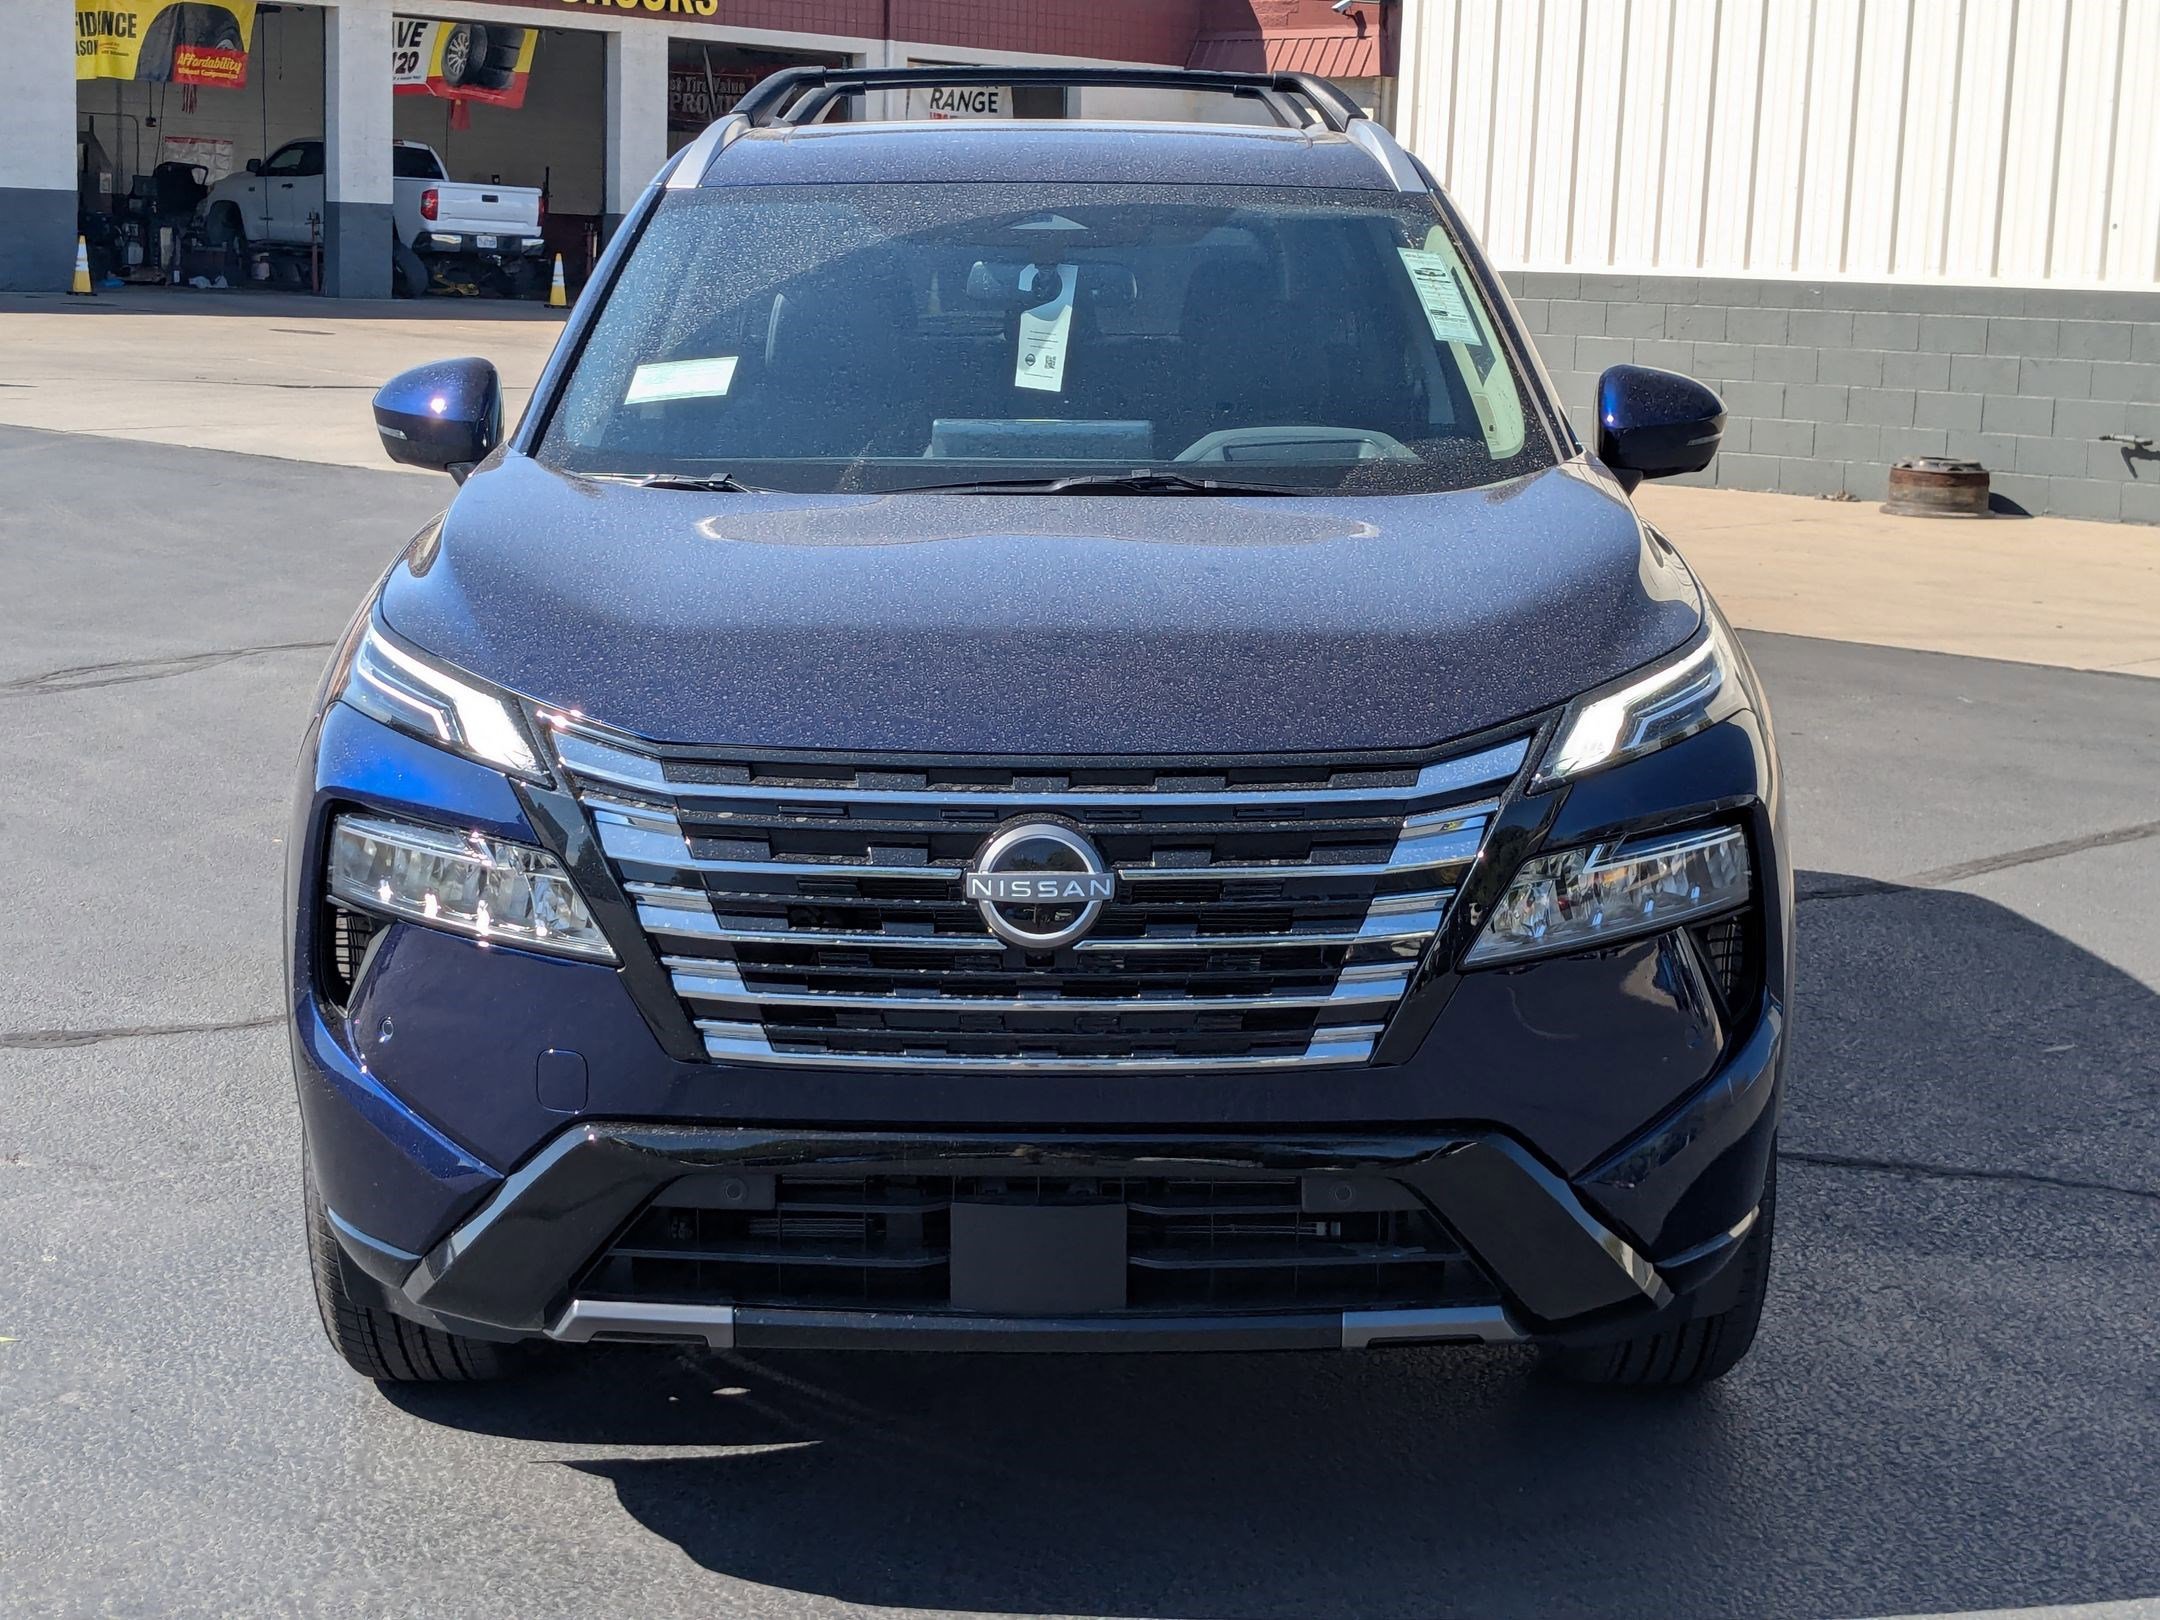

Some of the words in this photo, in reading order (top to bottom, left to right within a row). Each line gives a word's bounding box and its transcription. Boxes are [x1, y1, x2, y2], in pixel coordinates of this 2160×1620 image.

[75, 11, 137, 38] IDNCE
[392, 21, 428, 48] VE
[177, 52, 243, 75] Affordability
[930, 87, 999, 113] RANGE
[971, 878, 1111, 898] NISSAN
